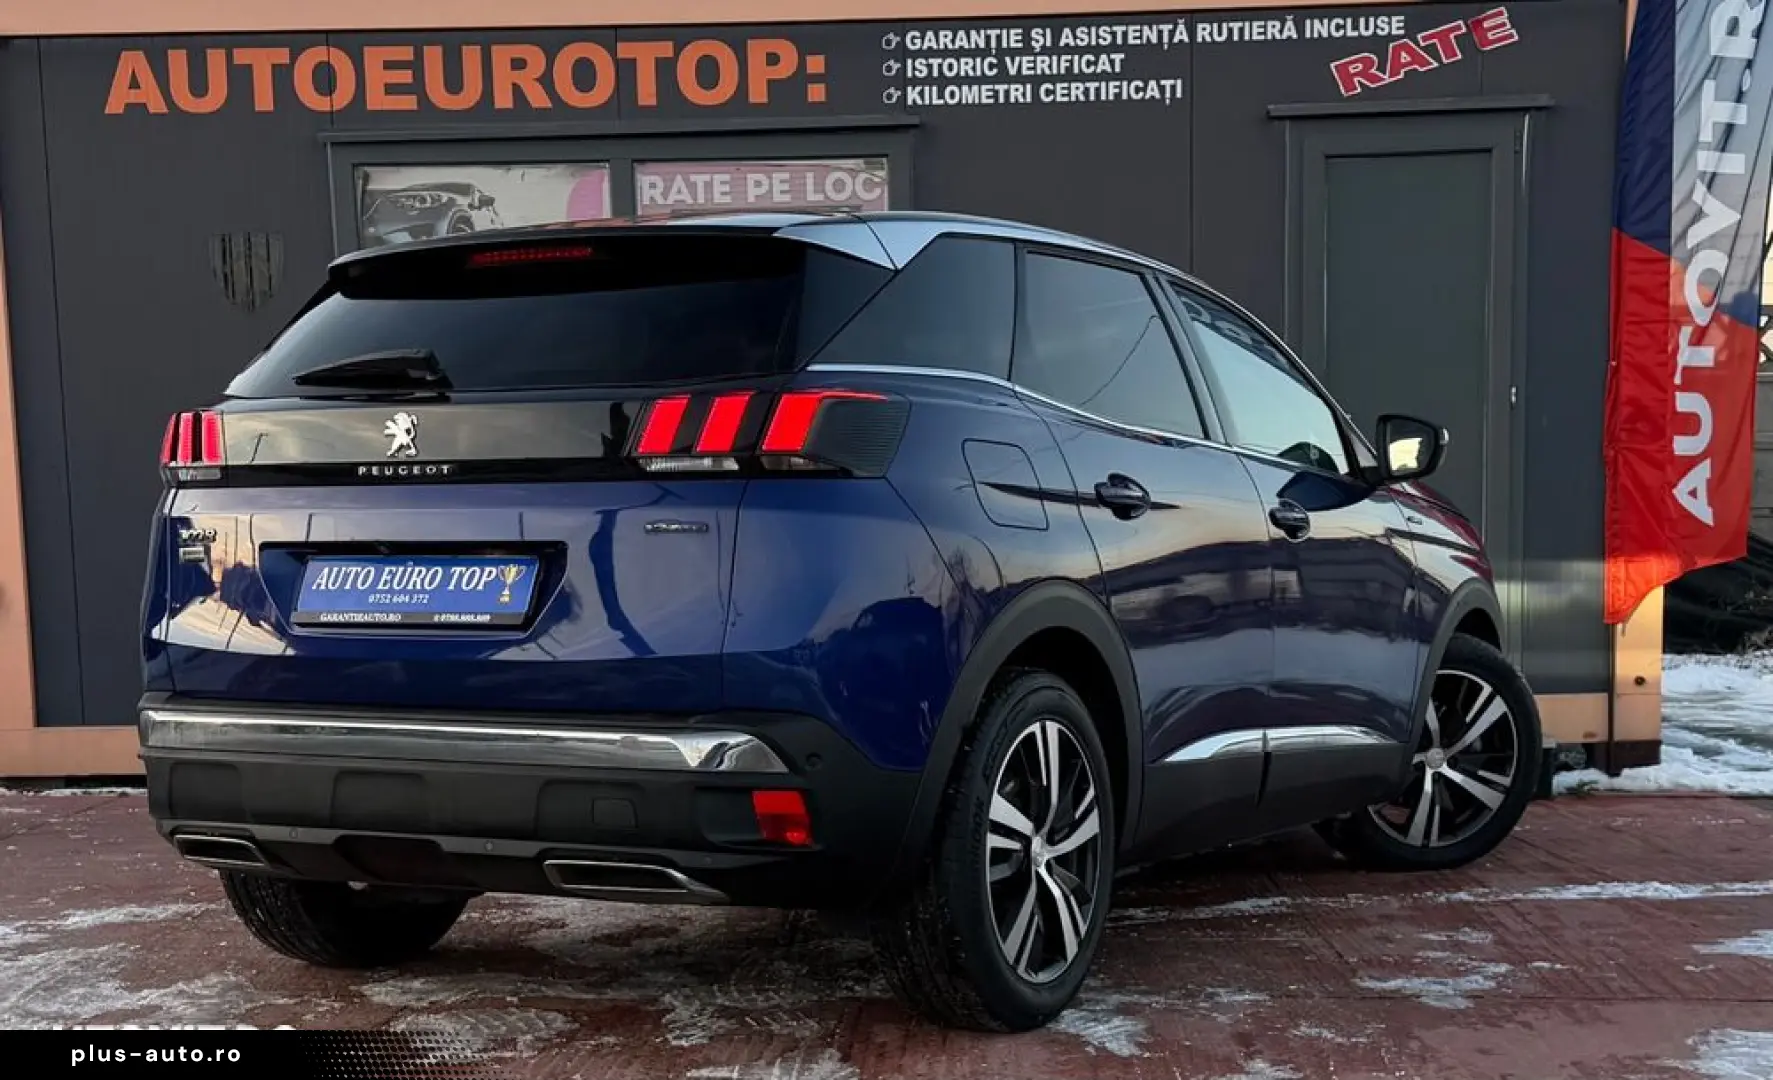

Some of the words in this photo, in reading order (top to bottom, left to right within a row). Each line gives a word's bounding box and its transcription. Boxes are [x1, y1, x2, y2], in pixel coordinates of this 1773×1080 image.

[1196, 15, 1298, 43] RUTIERĂ
[1304, 15, 1406, 39] INCLUSE
[1330, 7, 1519, 97] RATE
[104, 38, 827, 115] AUTOEUROTOP:
[906, 56, 999, 79] ISTORIC
[1005, 53, 1125, 76] VERIFICAT
[906, 83, 1033, 106] KILOMETRI
[643, 174, 733, 205] RATE
[746, 172, 791, 203] PE
[805, 171, 883, 202] LOC
[357, 464, 452, 476] PEUGEOT
[311, 566, 375, 591] AUTO
[447, 566, 498, 591] TOP
